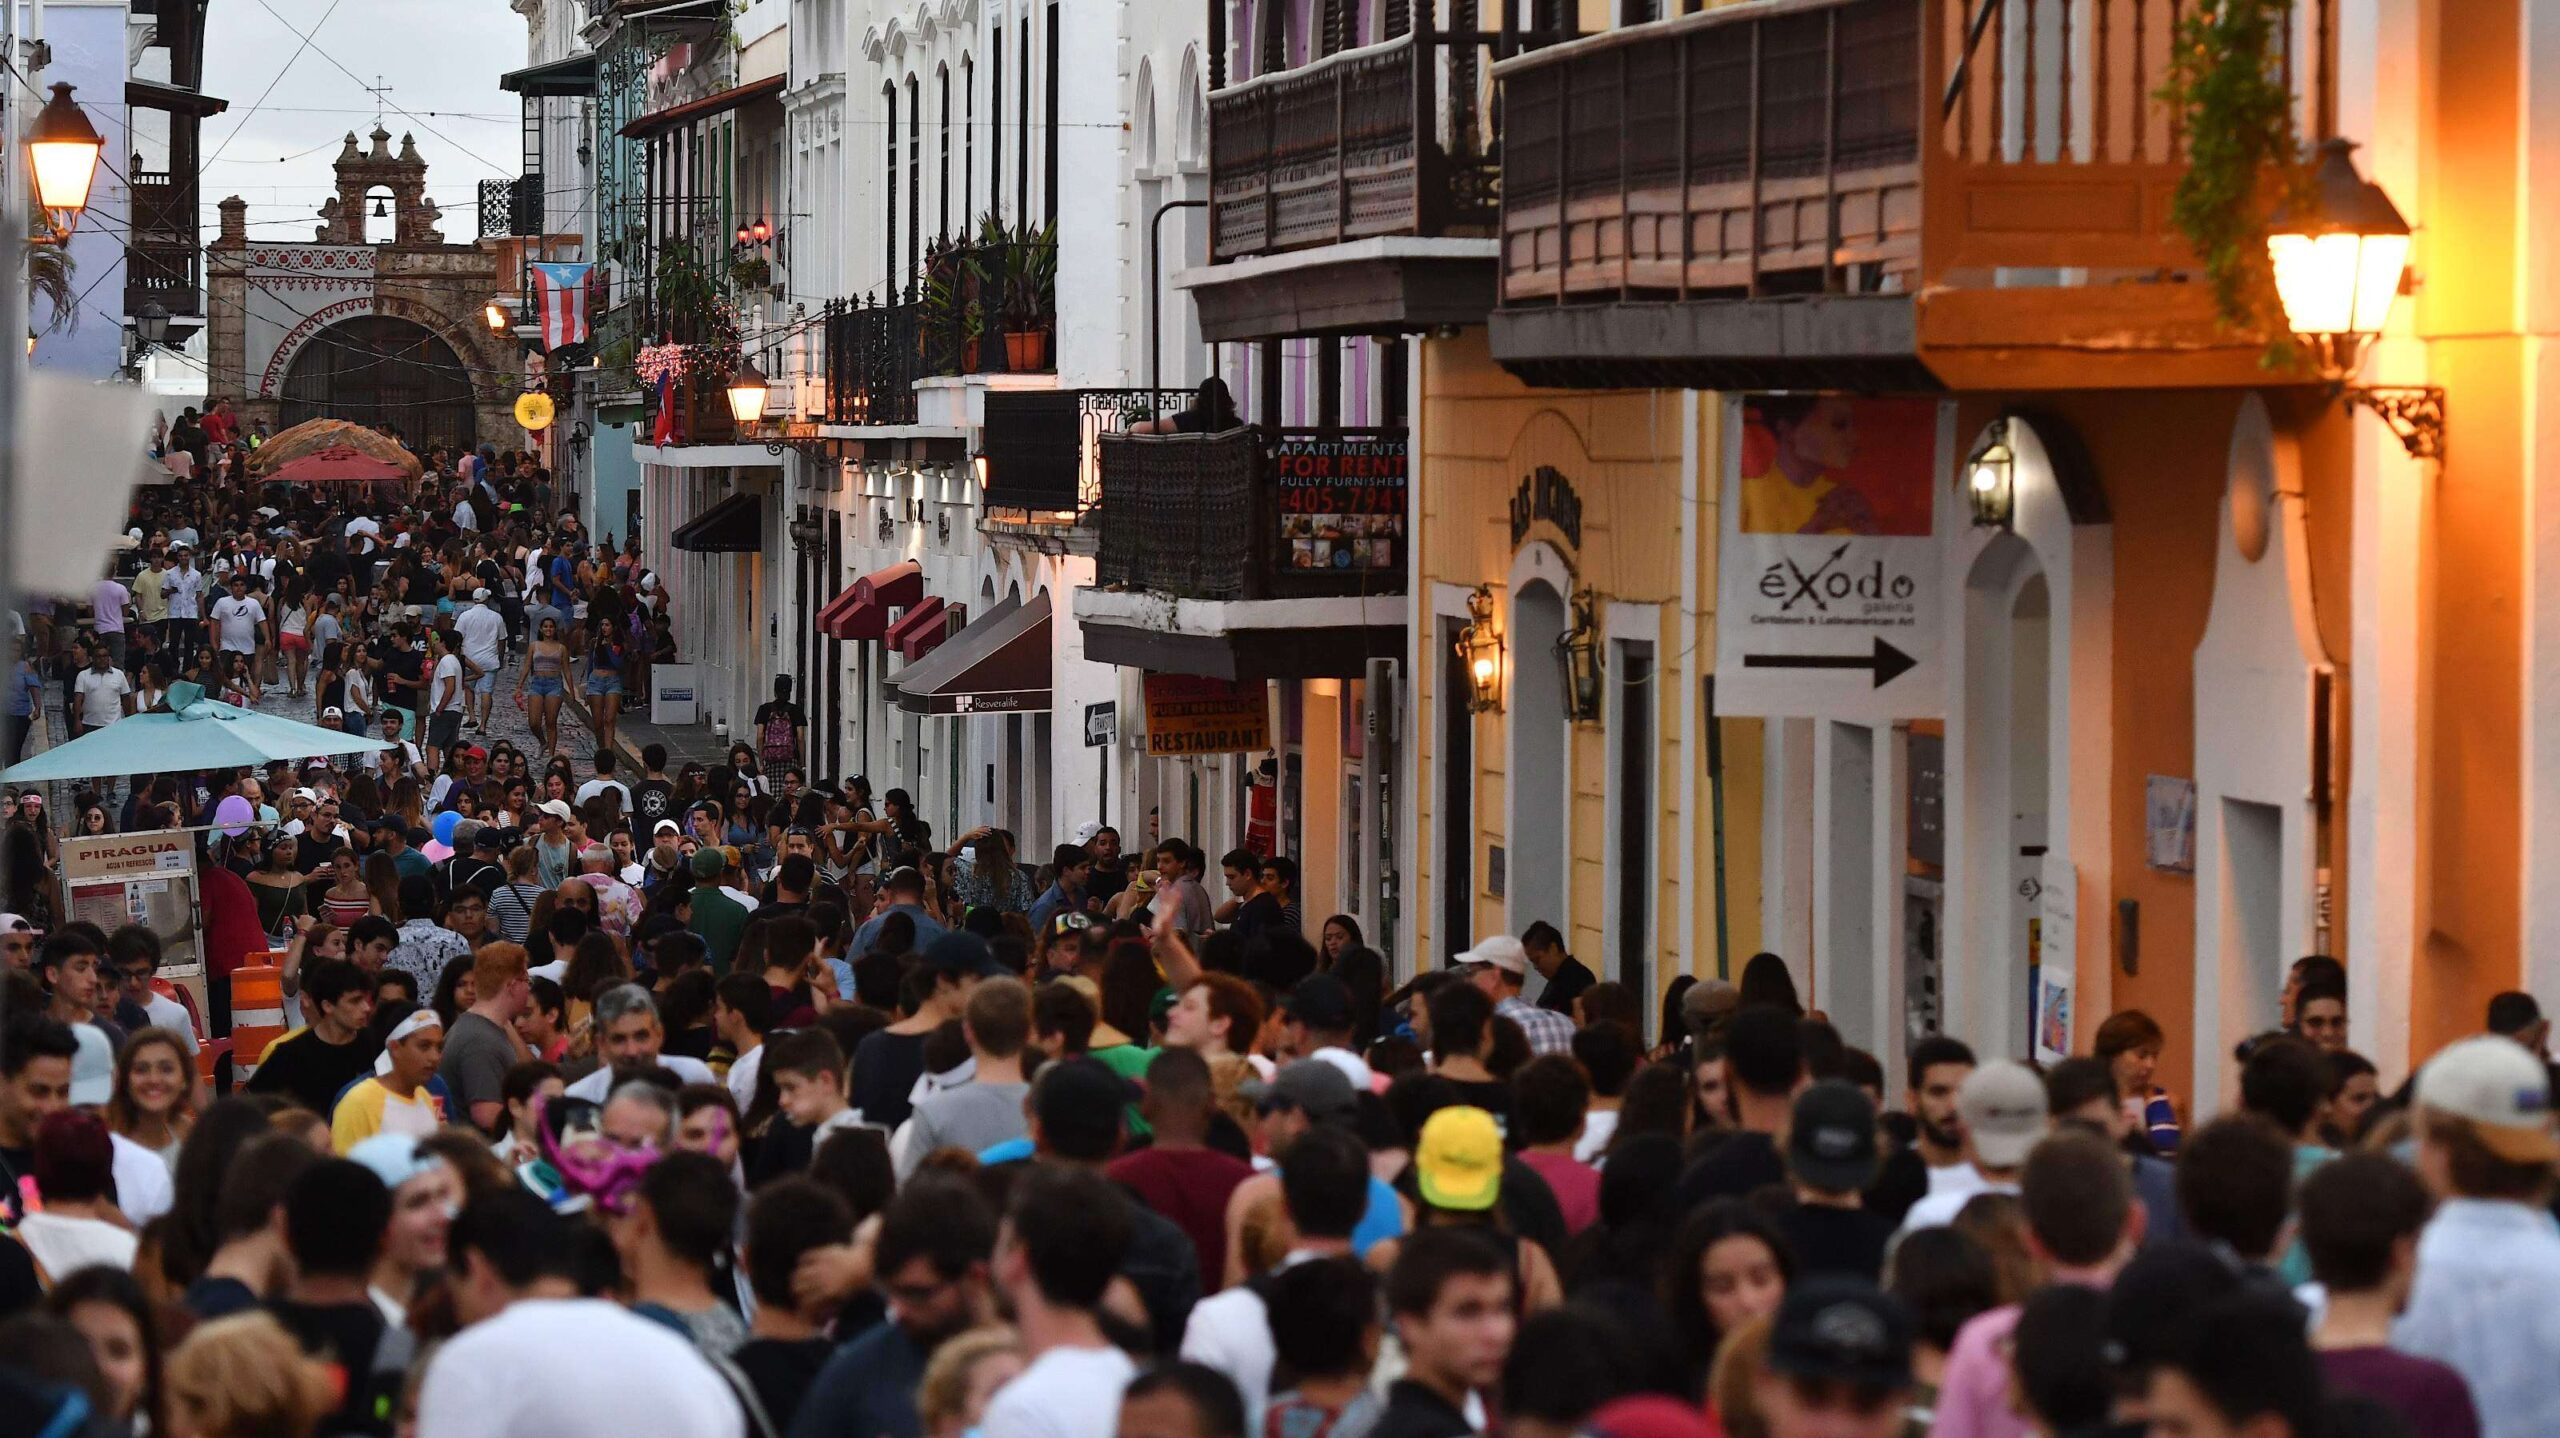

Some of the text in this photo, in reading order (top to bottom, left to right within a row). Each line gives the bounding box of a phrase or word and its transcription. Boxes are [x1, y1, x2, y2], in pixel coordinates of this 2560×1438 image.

[1278, 443, 1406, 456] APARTMENTS
[1280, 456, 1407, 476] FOR RENT
[1280, 477, 1405, 487] FULLY FURNISHED
[975, 696, 1018, 708] Resveralife
[1152, 728, 1264, 752] RESTAURANT
[79, 843, 178, 861] PIRAGUA
[106, 861, 120, 870] AGUA
